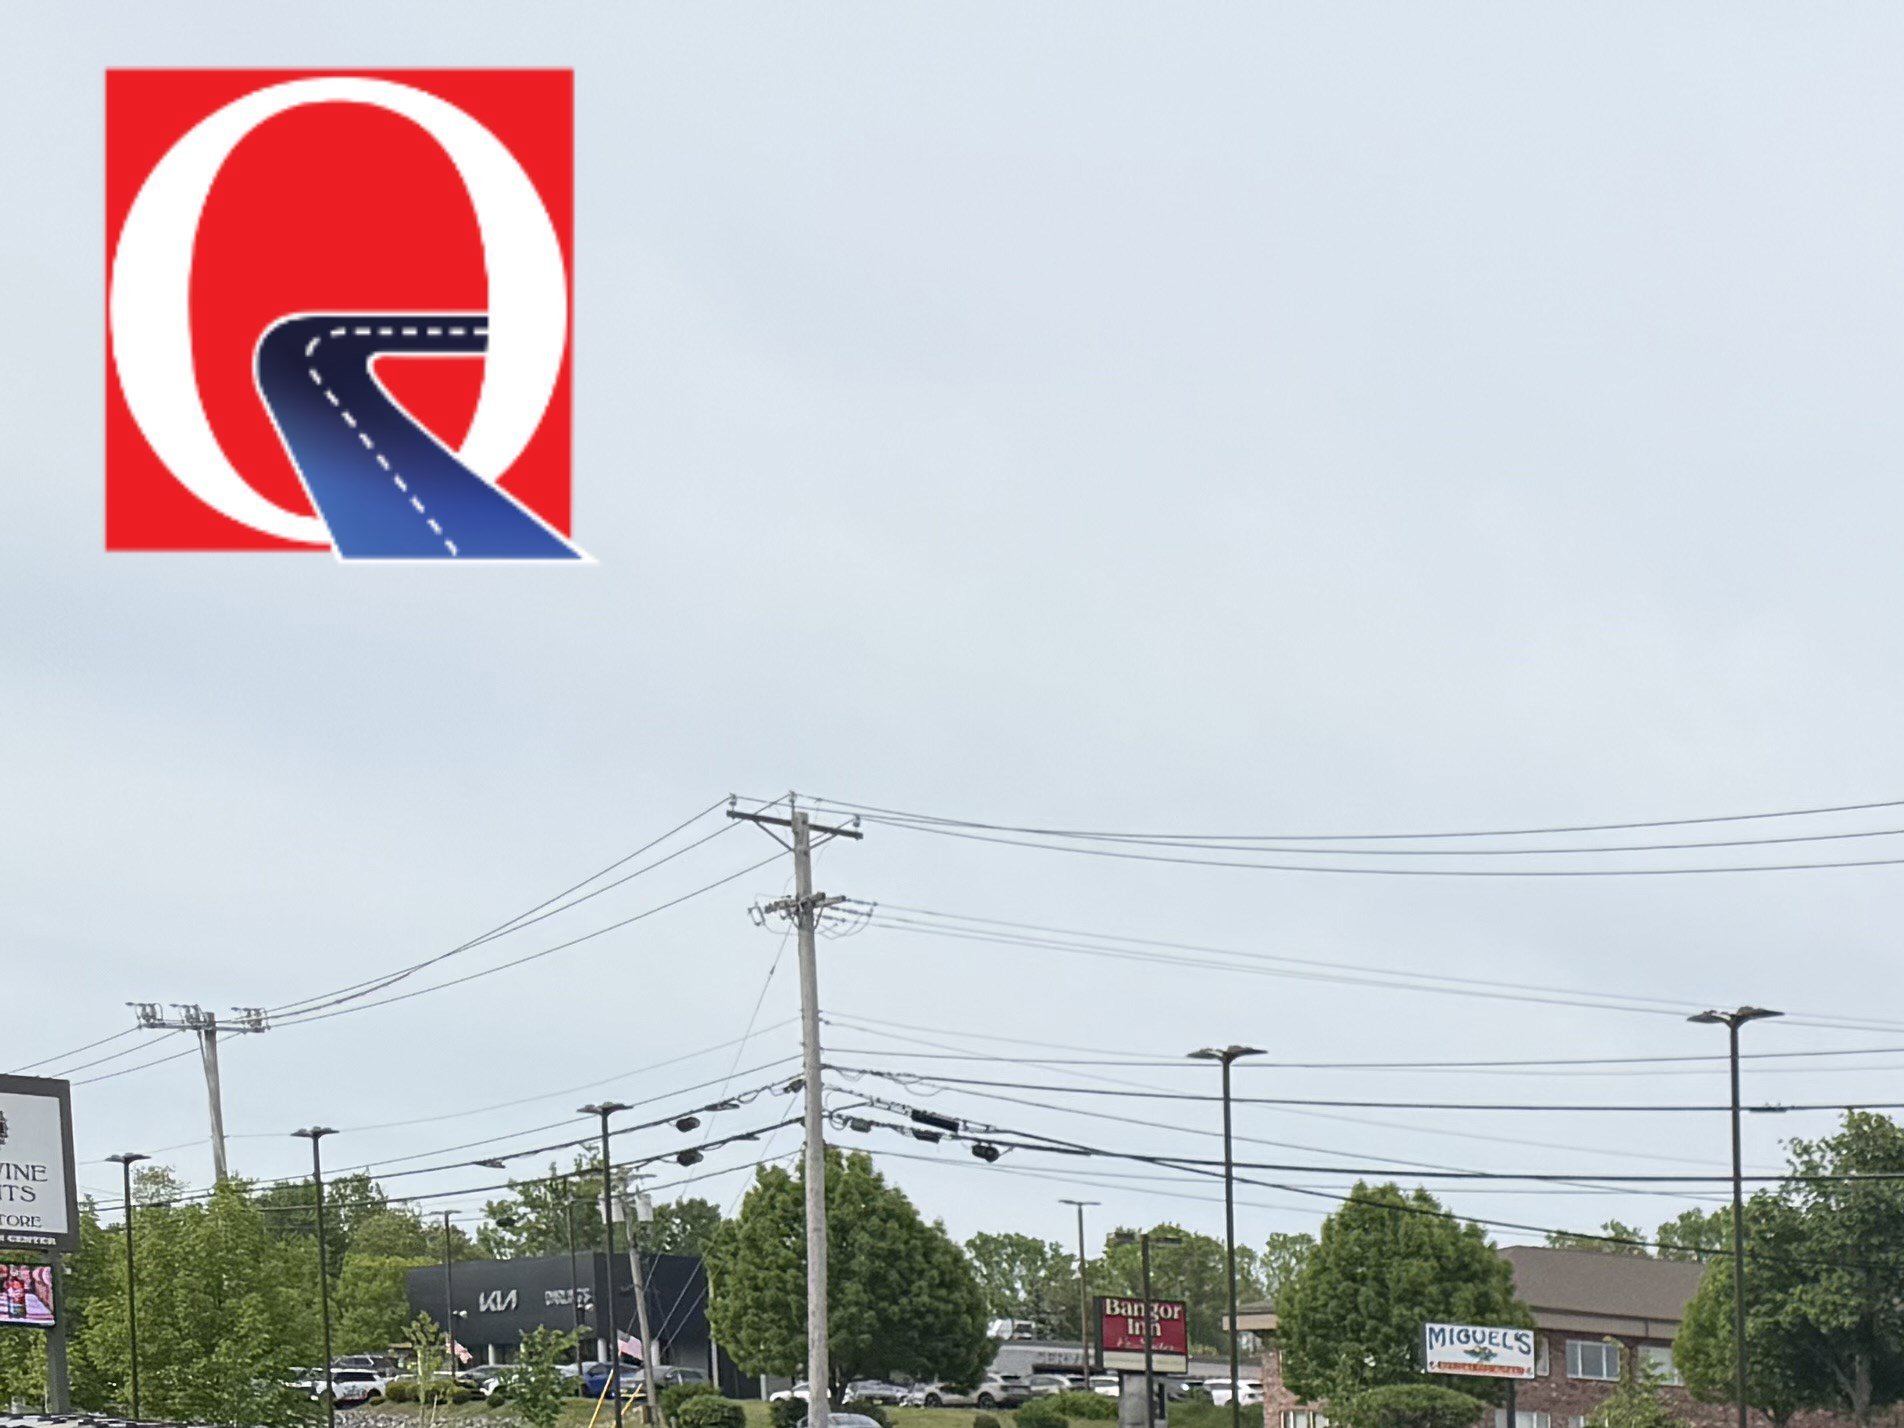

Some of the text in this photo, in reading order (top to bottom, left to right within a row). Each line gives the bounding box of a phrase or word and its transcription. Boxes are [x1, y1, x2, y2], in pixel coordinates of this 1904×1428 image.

[0, 1183, 36, 1203] TS
[479, 1289, 518, 1312] KIA
[1105, 1298, 1182, 1321] Bangor
[1127, 1318, 1162, 1337] Inn
[1428, 1326, 1533, 1356] MIGUEL'S
